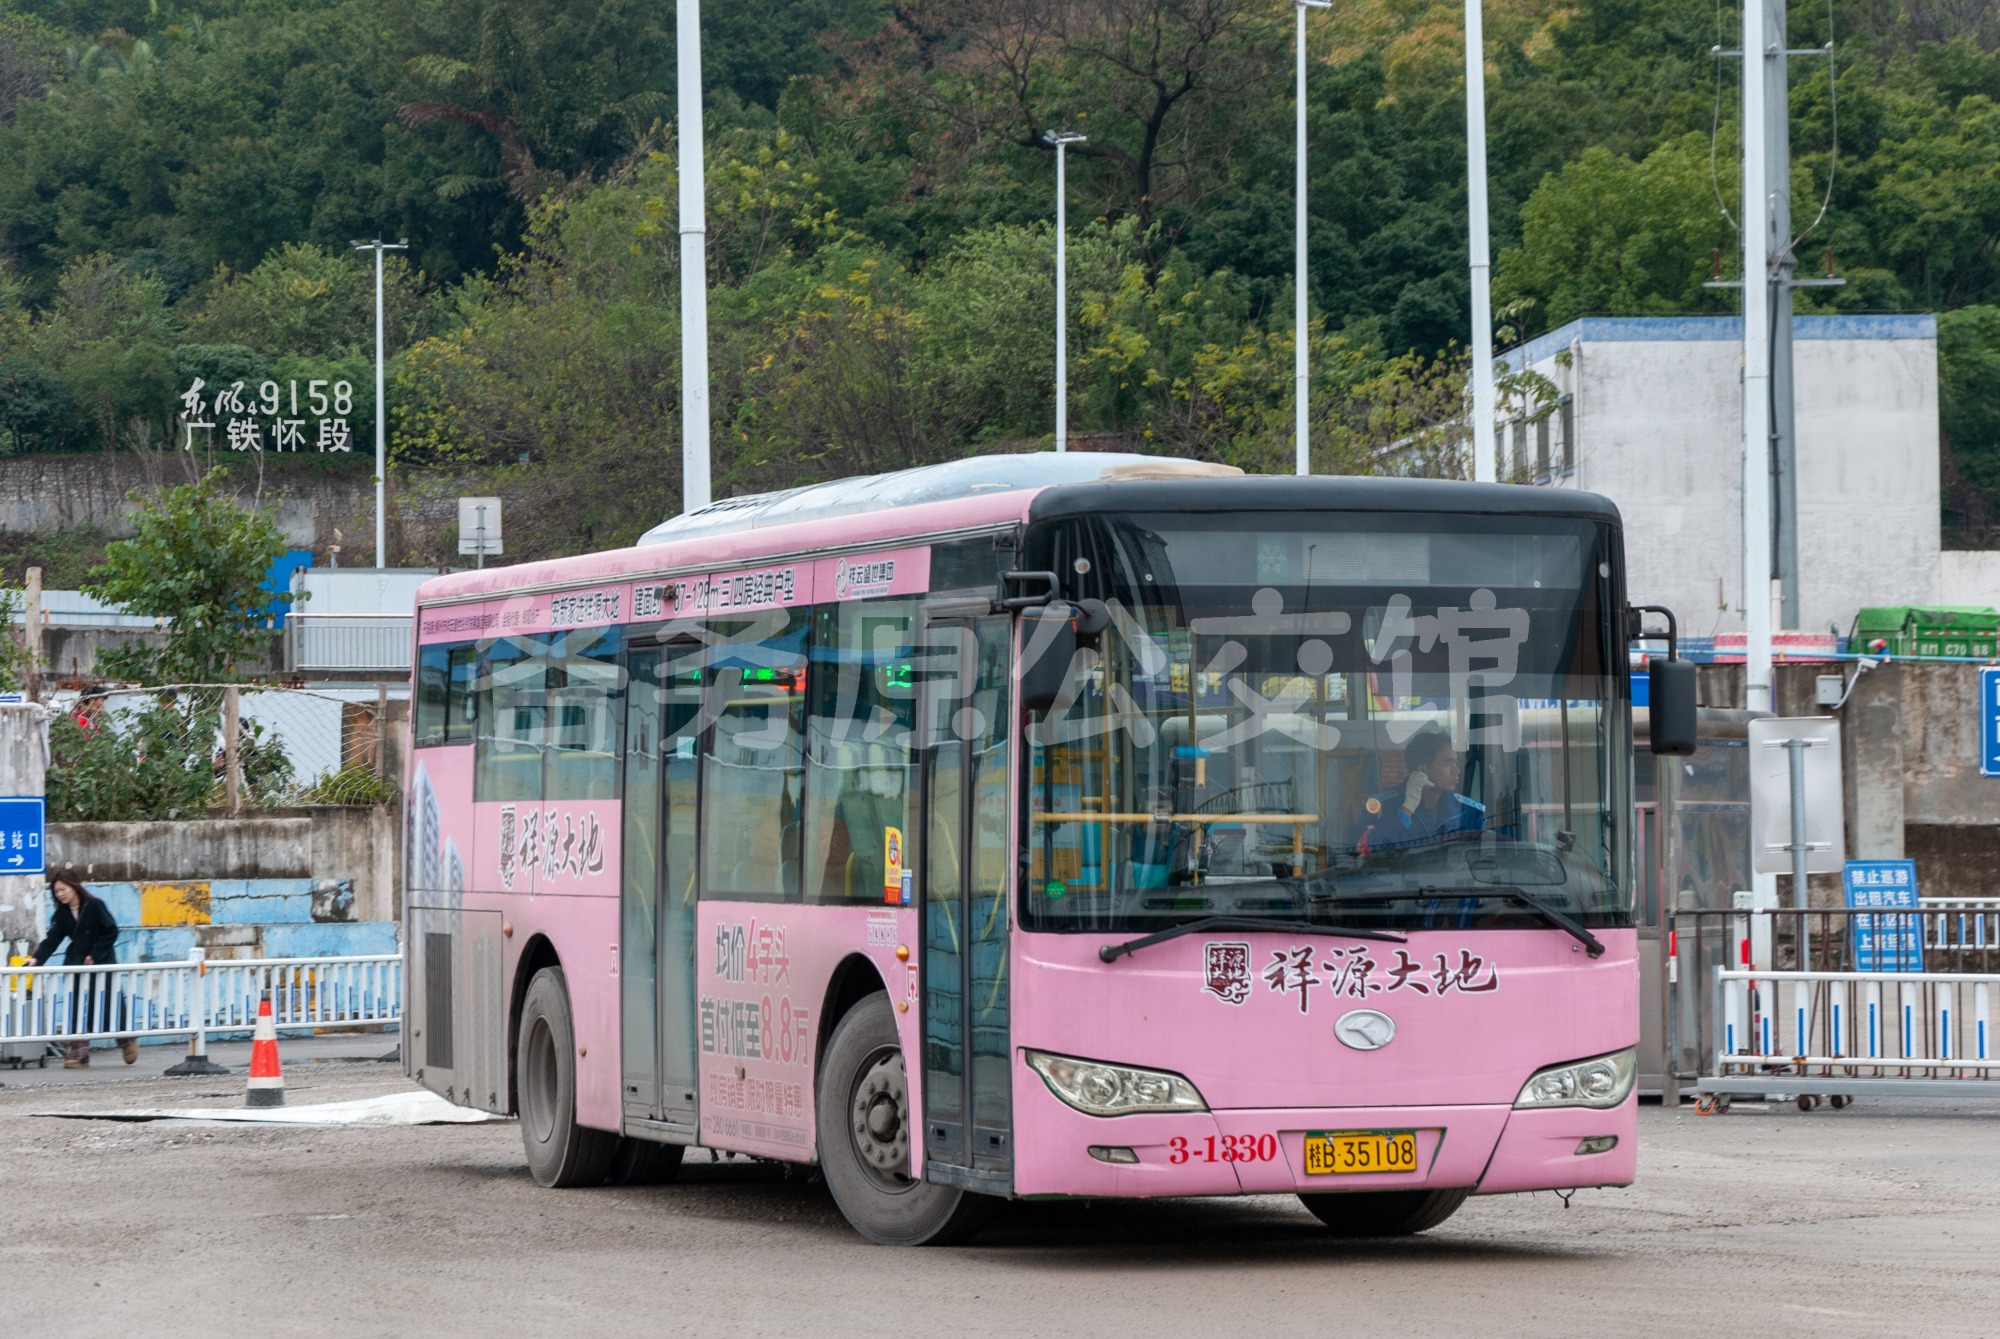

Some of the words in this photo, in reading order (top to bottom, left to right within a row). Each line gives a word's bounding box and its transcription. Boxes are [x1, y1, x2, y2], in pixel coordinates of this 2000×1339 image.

[518, 808, 605, 899] 祥源大地
[1851, 869, 1910, 886] 禁止巡游
[1854, 890, 1912, 907] 出租汽车
[715, 918, 790, 987] 均价4字头
[1263, 945, 1498, 1014] 祥源大地
[700, 993, 810, 1066] 首付低至8.8万
[1168, 1133, 1278, 1166] 3-1330
